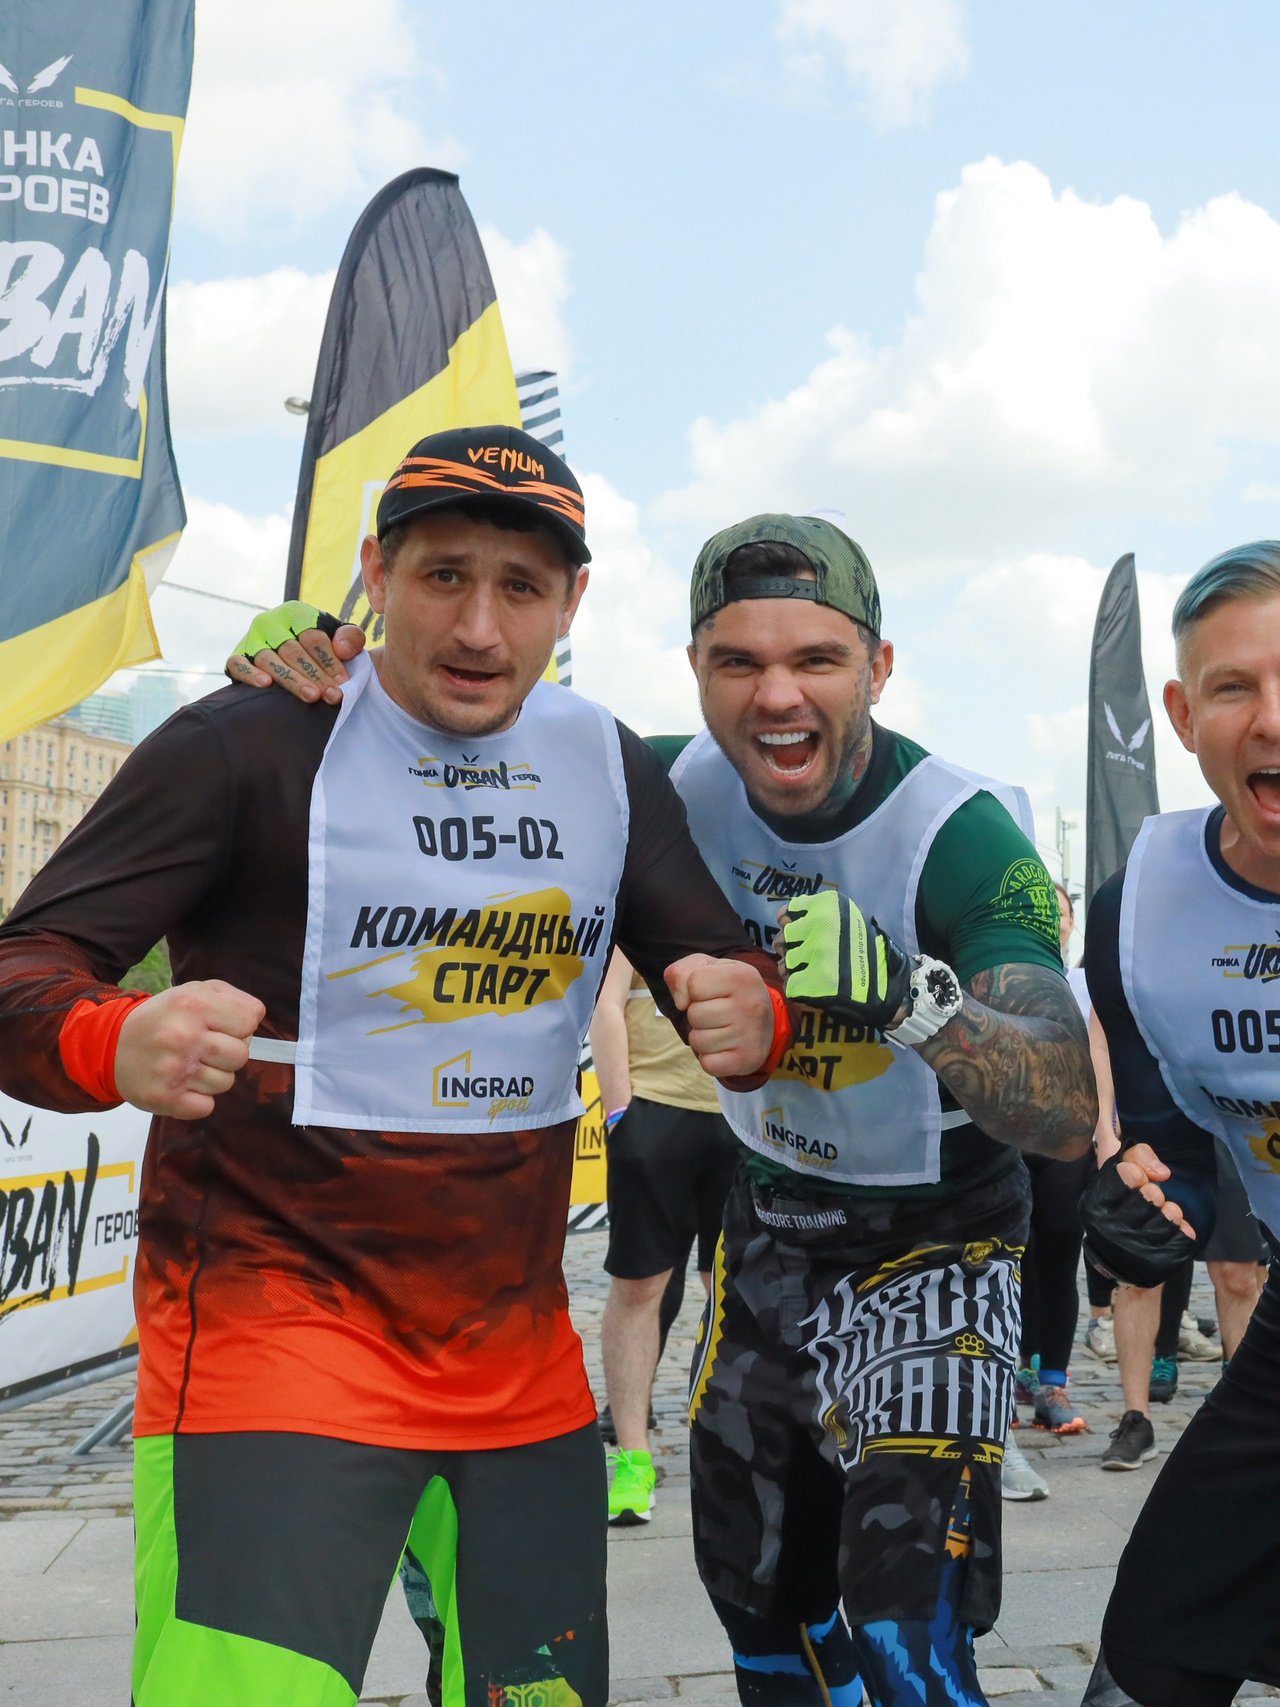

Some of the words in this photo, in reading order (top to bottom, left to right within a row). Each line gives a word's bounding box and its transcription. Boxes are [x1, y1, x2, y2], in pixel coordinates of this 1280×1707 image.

[18, 99, 64, 108] ГЕРОЕВ
[4, 130, 104, 178] НКА
[467, 446, 545, 480] VENUM
[408, 766, 439, 777] ГОНКА
[444, 760, 511, 790] URBAN
[412, 815, 565, 861] 005-02
[752, 864, 824, 902] URBAN
[350, 906, 606, 960] КОМАНДНЫЙ
[858, 954, 866, 987] advanced
[1211, 957, 1240, 967] ГОНКА
[433, 962, 550, 1005] СТАРТ
[442, 1076, 534, 1099] INGRAD
[487, 1083, 534, 1125] sport
[765, 1121, 838, 1161] INGRAD
[791, 1209, 847, 1229] TRAINING
